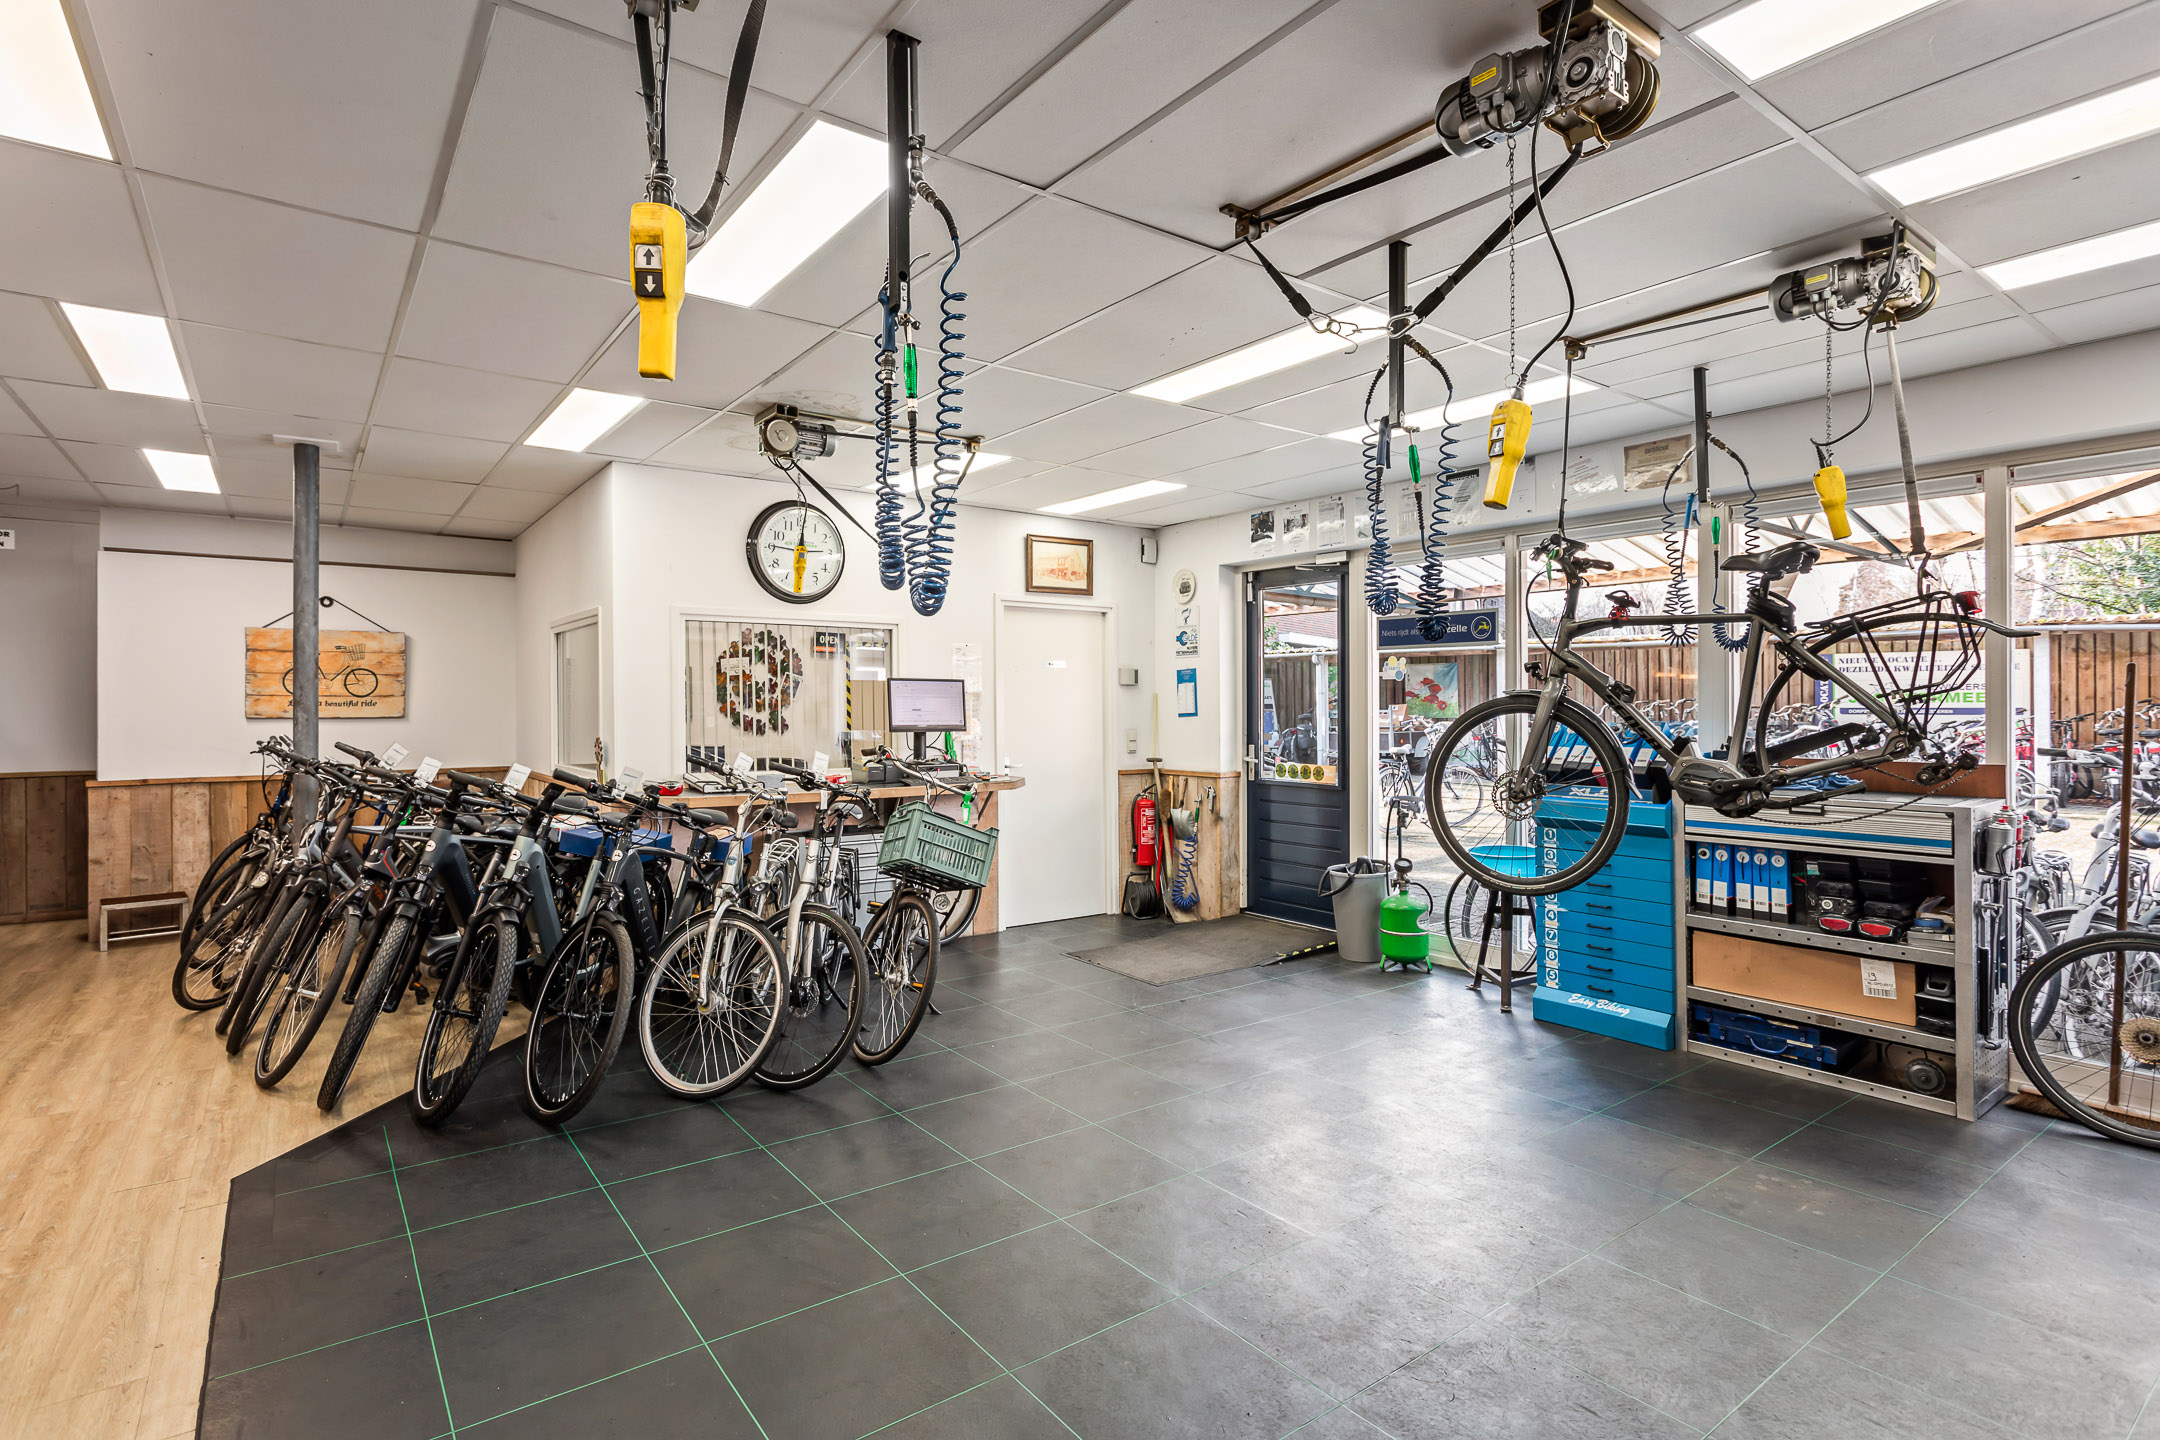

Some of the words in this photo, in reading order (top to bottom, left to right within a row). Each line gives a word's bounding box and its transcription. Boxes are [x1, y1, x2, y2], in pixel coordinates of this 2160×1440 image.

[773, 530, 785, 541] 10
[325, 700, 359, 708] beautiful
[1548, 850, 1554, 859] 3
[633, 887, 656, 951] GAZELLE
[1548, 910, 1554, 919] 4
[1548, 931, 1554, 939] 7
[1548, 950, 1554, 959] 8
[1549, 970, 1555, 979] 5
[1568, 993, 1596, 1008] Easy
[1595, 999, 1631, 1017] Biking
